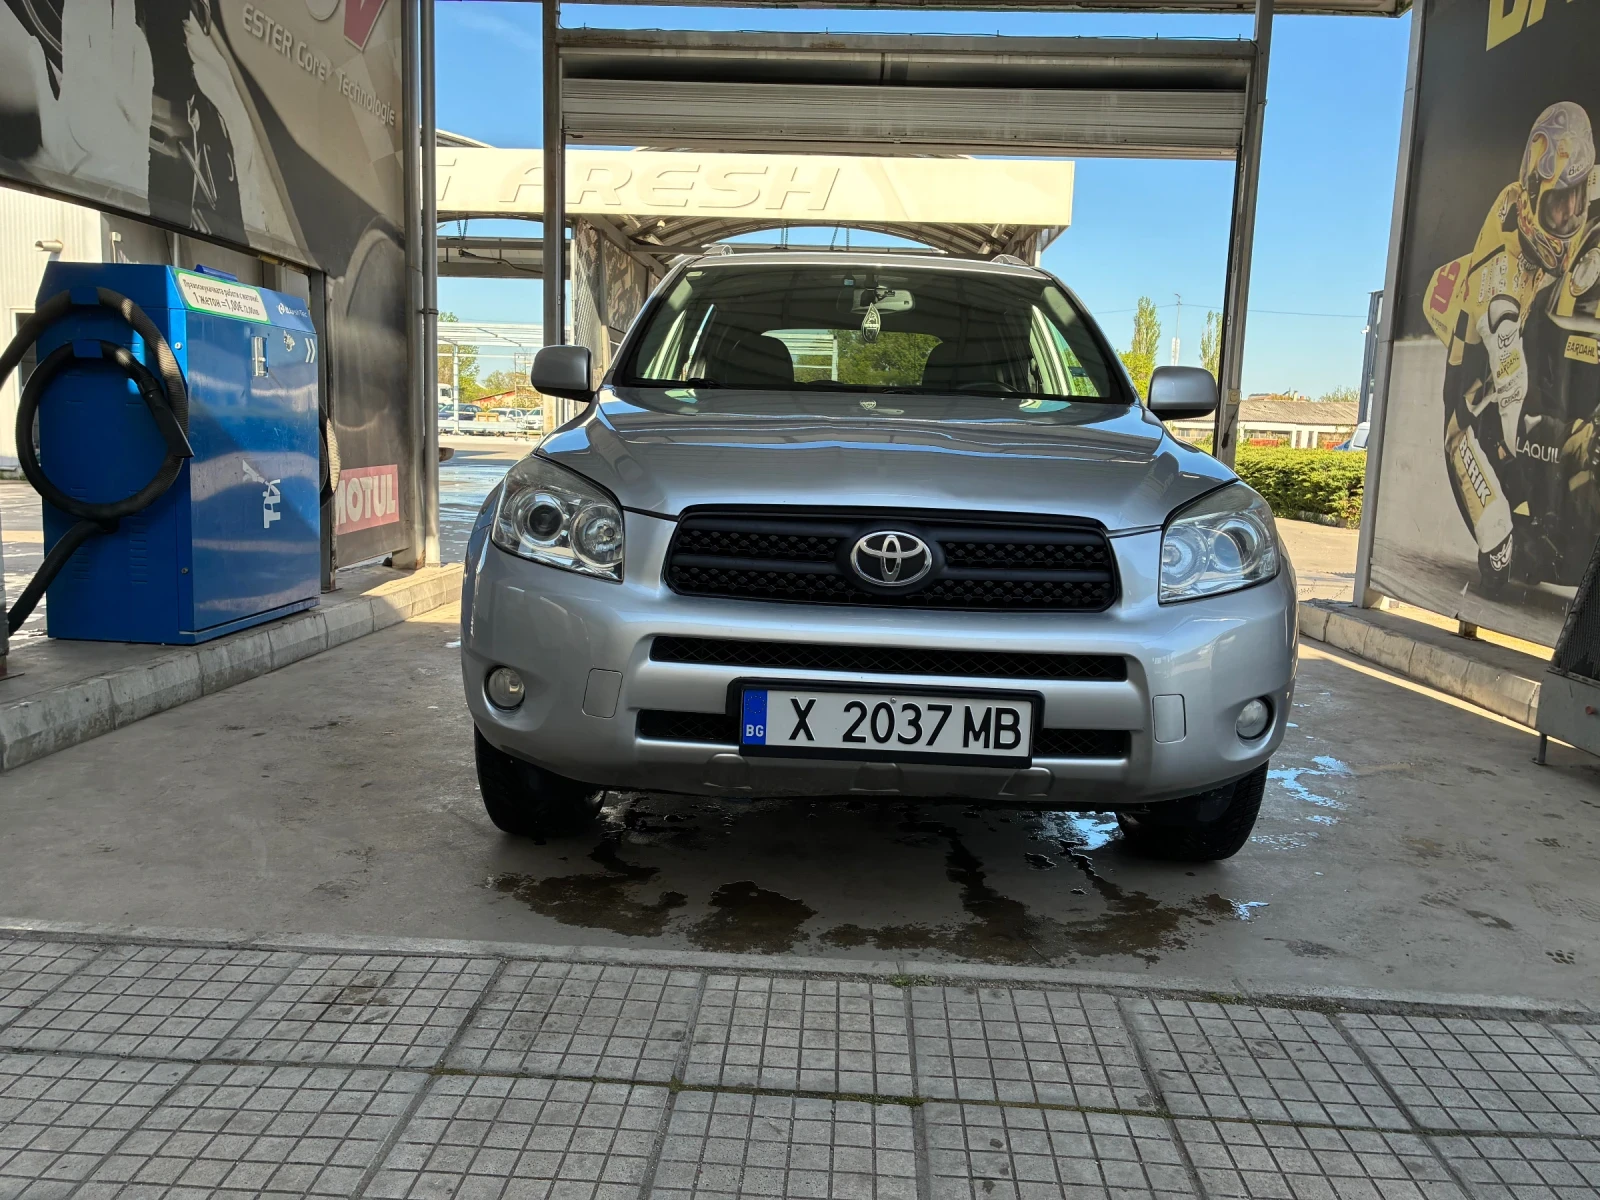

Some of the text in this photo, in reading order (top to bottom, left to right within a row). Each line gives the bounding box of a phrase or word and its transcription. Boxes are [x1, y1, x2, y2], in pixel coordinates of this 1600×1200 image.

[242, 3, 293, 58] ESTER
[336, 71, 396, 126] Technologie
[1566, 340, 1596, 360] BARDAHL
[1458, 433, 1492, 508] BERIK
[745, 724, 765, 738] BG
[788, 696, 1022, 750] X 2037 MB
